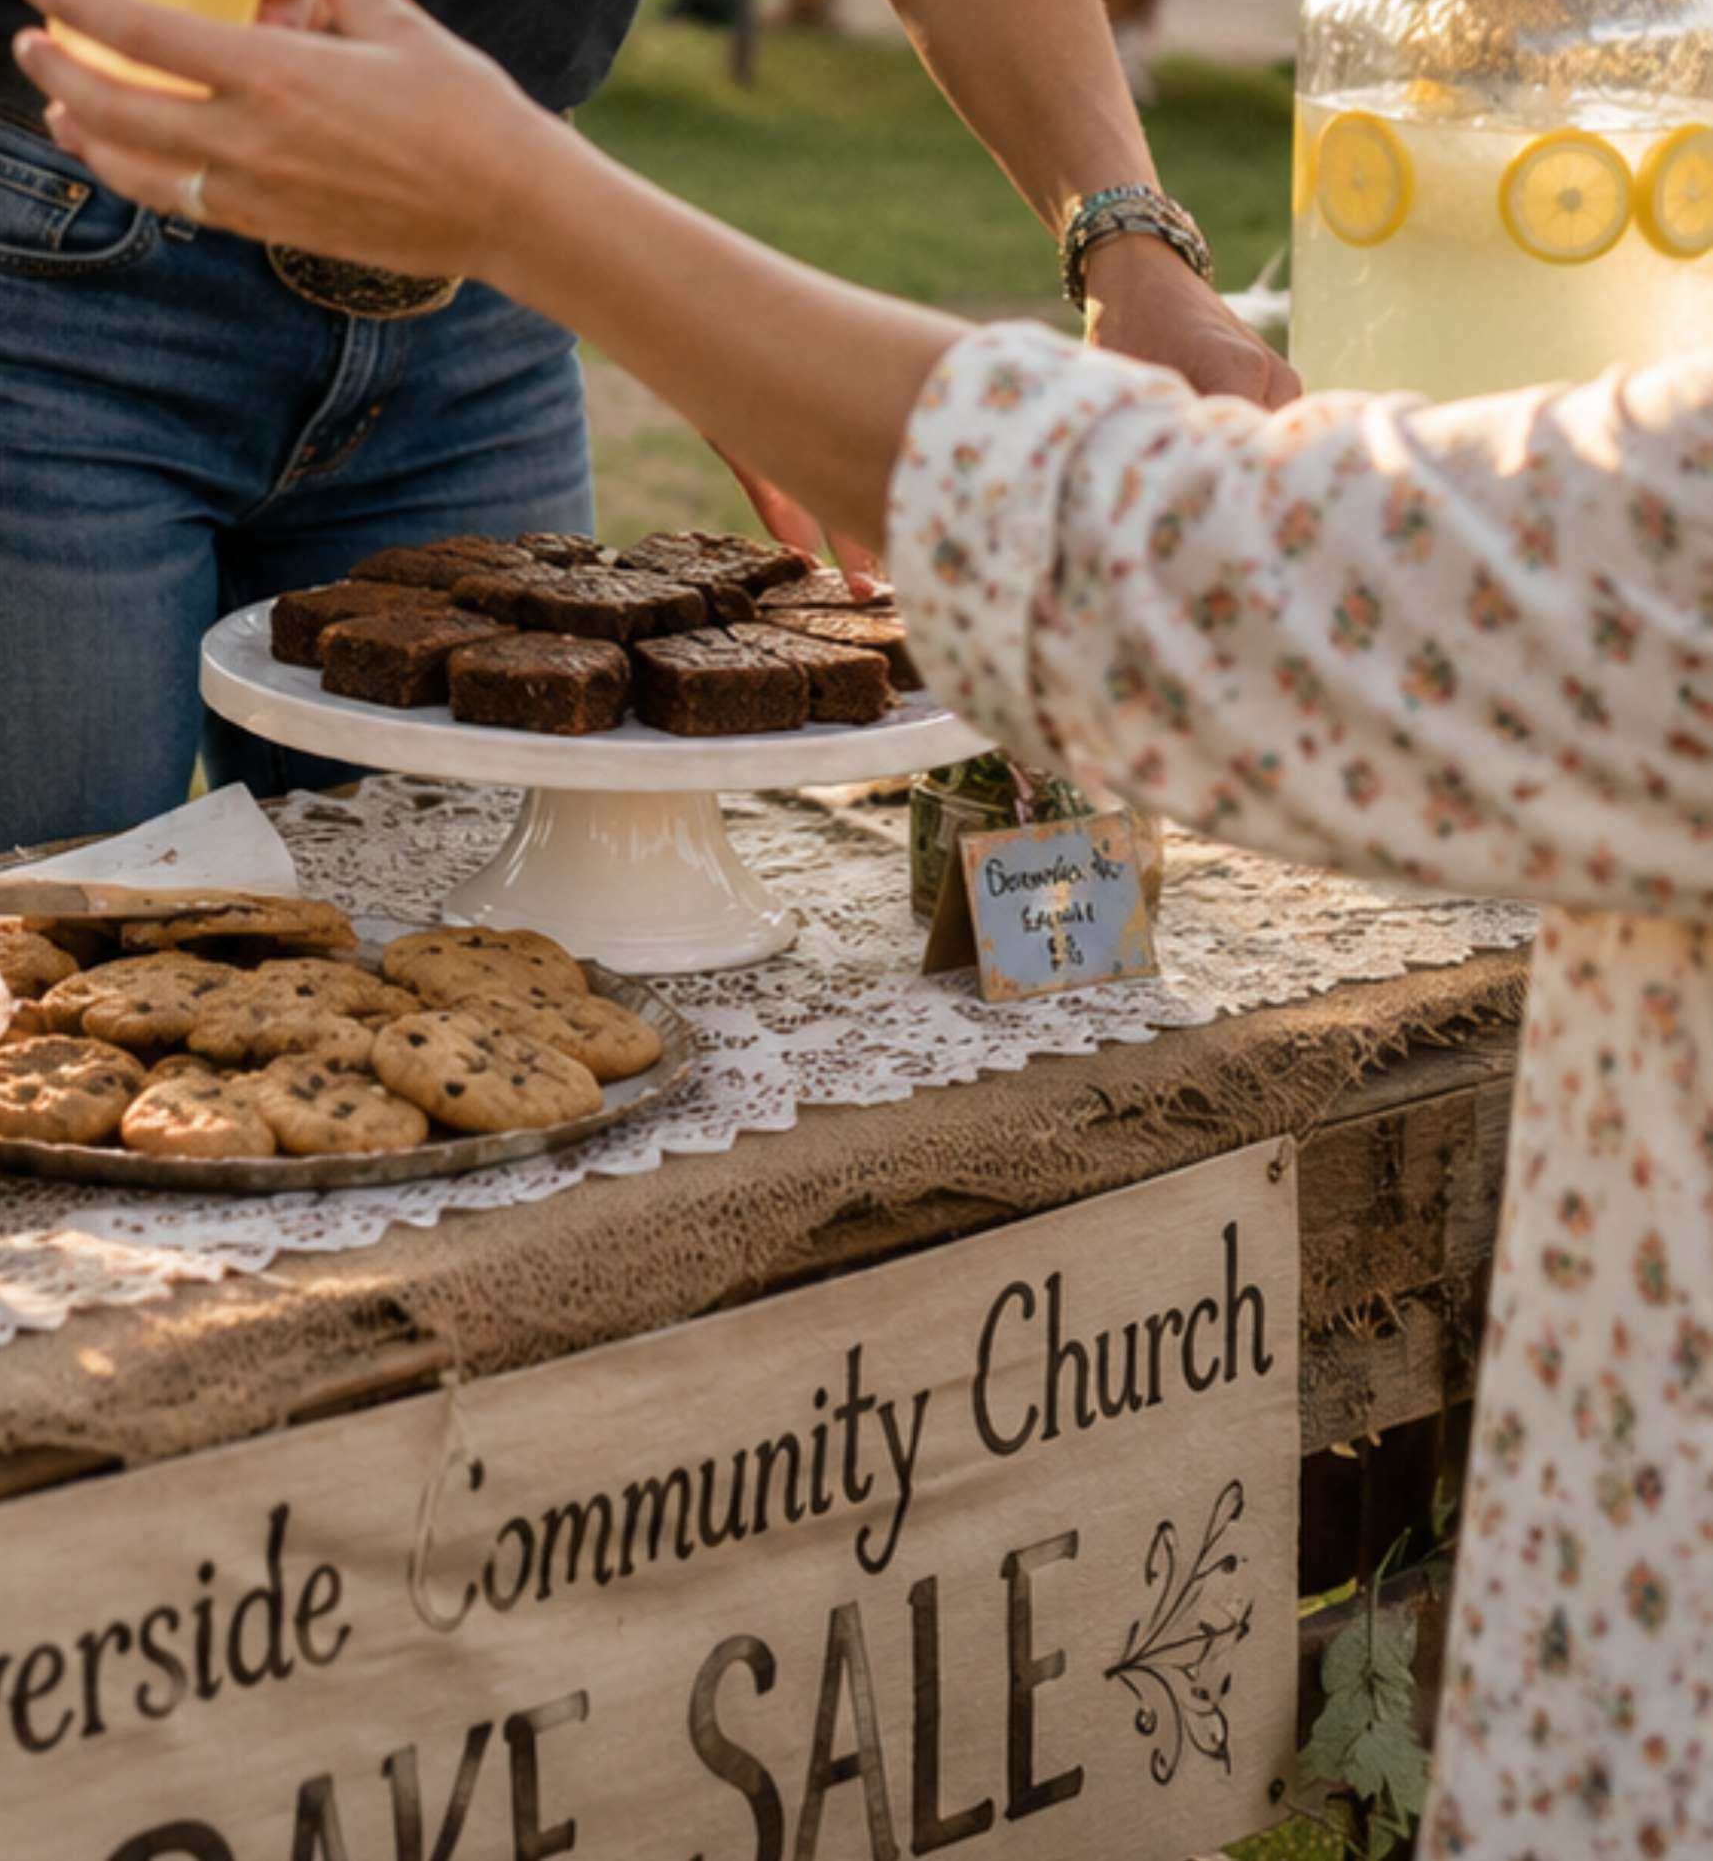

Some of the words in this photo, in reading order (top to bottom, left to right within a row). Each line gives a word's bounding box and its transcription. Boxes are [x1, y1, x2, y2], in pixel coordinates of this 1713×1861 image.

[407, 1344, 931, 1633] Community
[972, 1221, 1273, 1456] Church
[687, 1530, 1084, 1861] SALE
